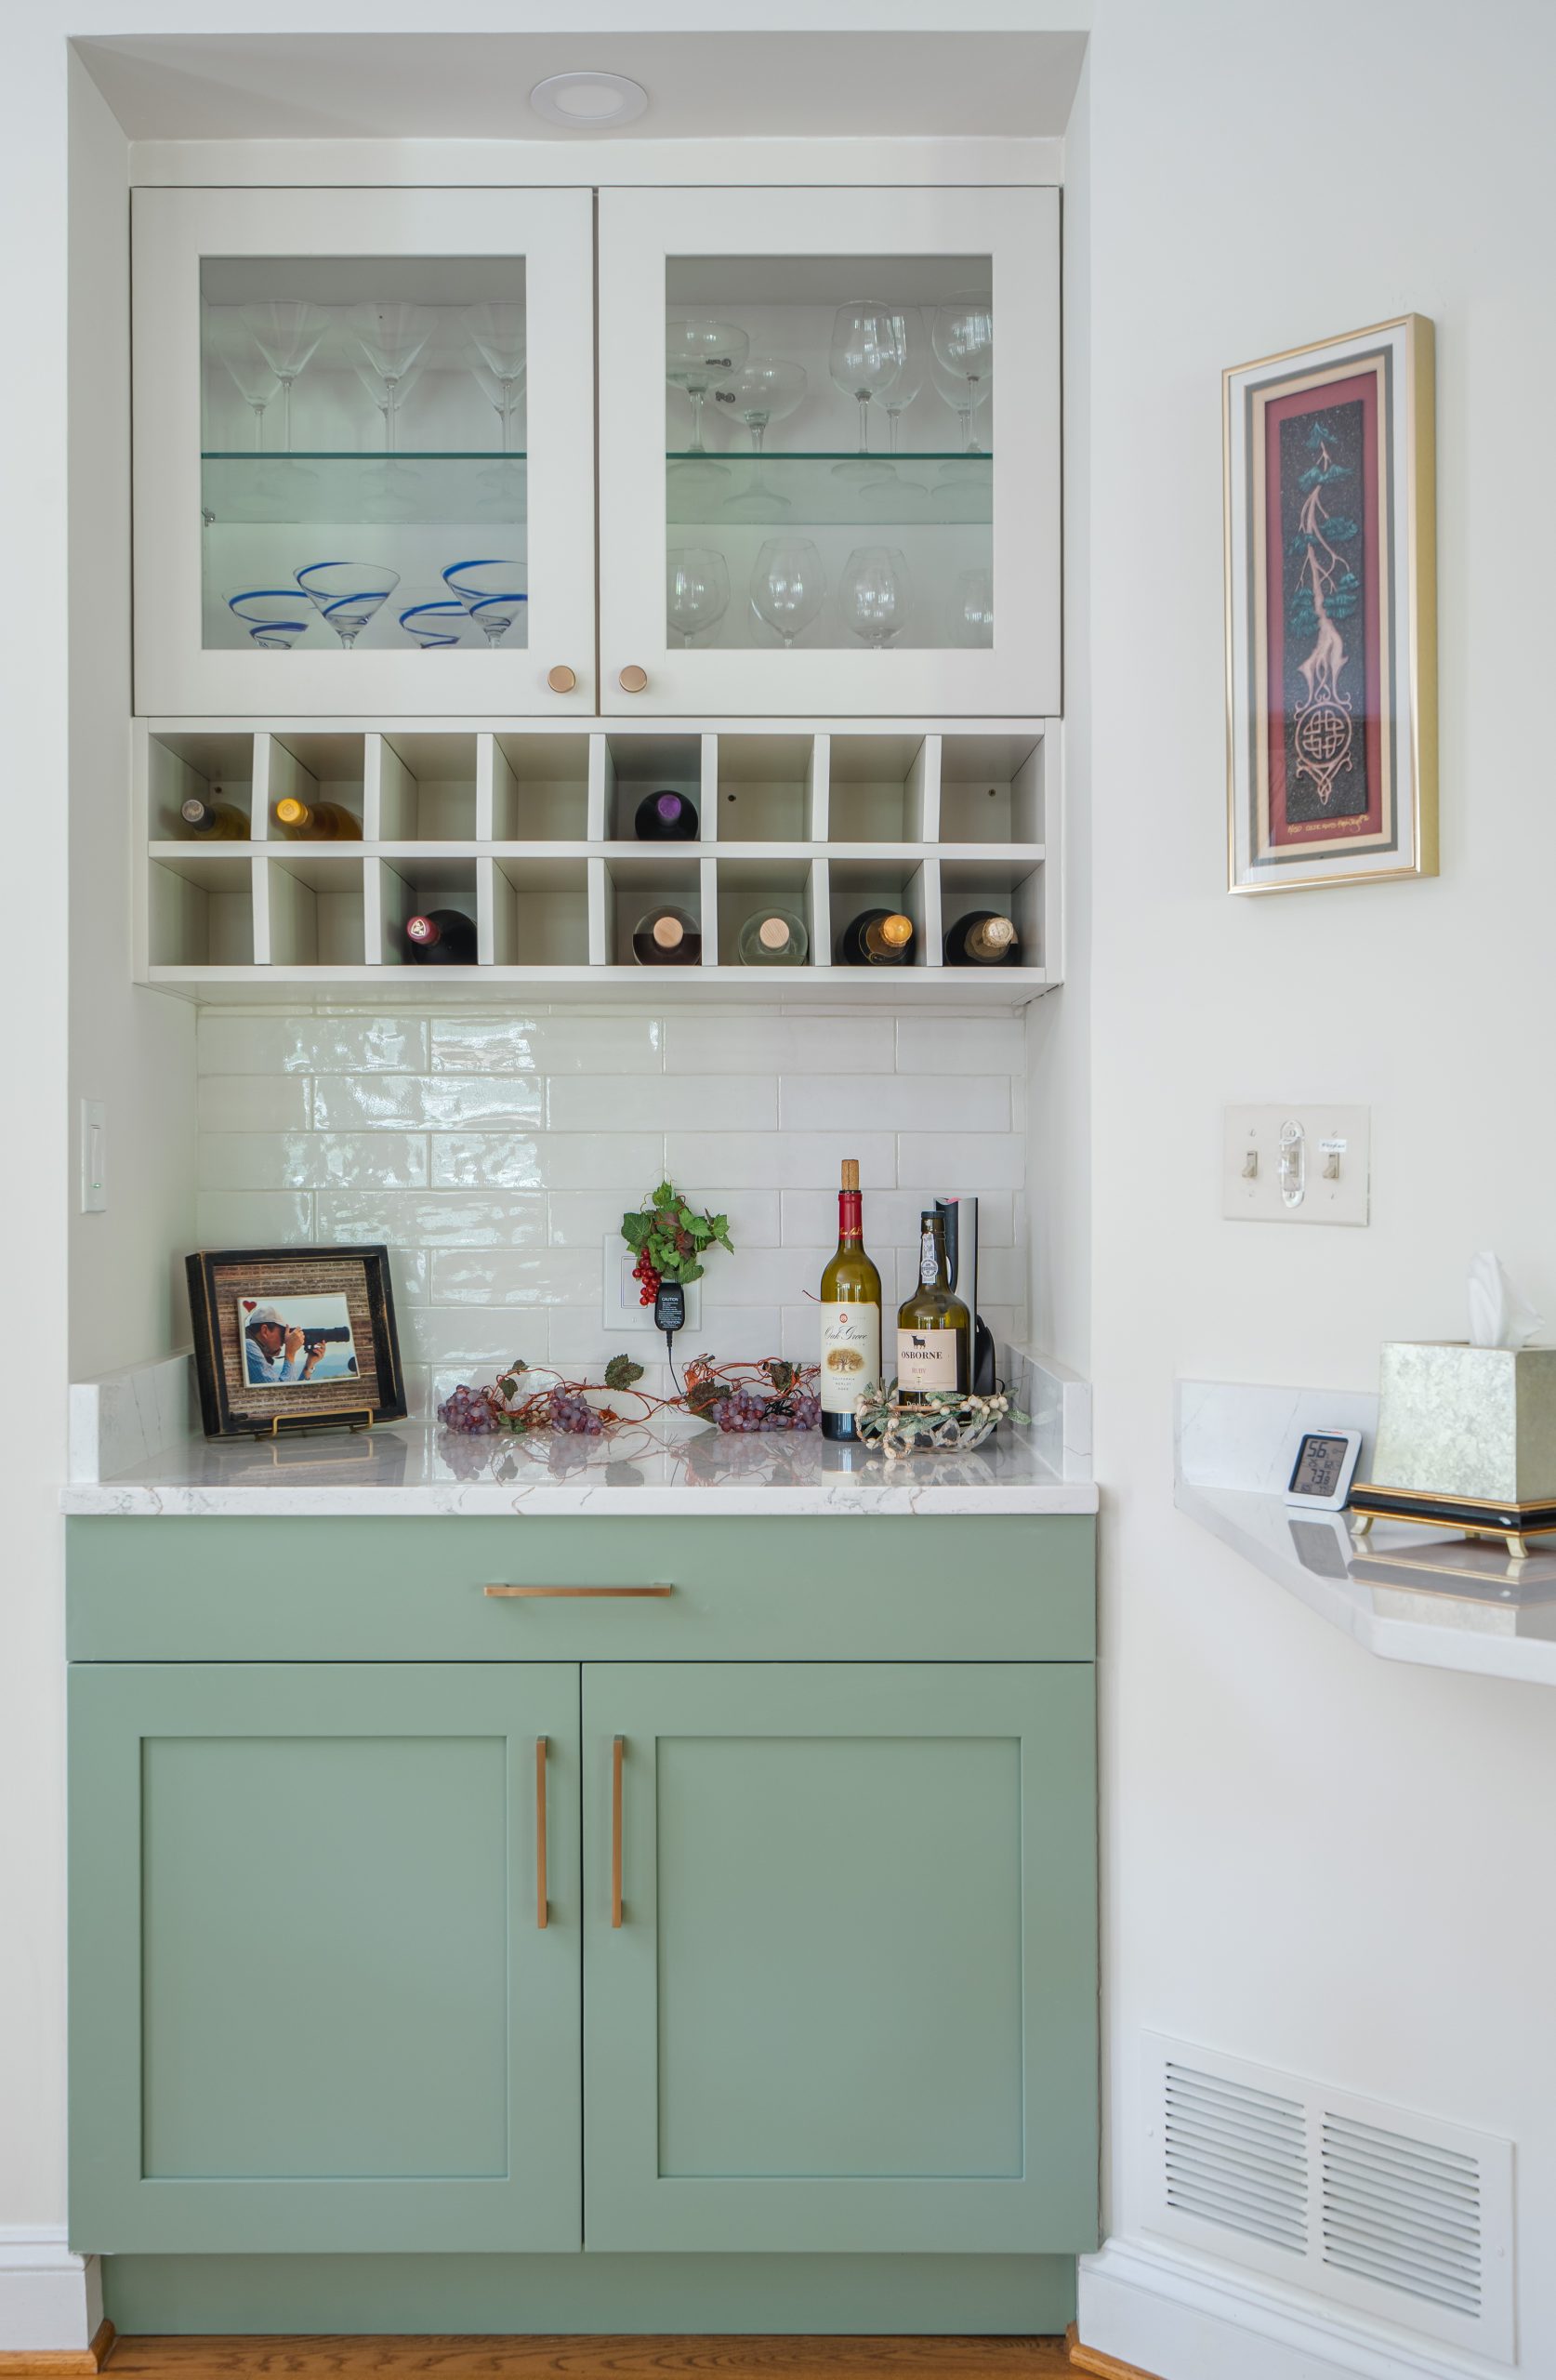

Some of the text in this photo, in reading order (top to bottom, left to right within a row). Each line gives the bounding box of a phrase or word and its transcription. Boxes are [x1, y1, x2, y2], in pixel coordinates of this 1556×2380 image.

[824, 1325, 868, 1341] Oak Grove
[901, 1351, 943, 1360] OSBORNE
[1307, 1441, 1328, 1458] 56
